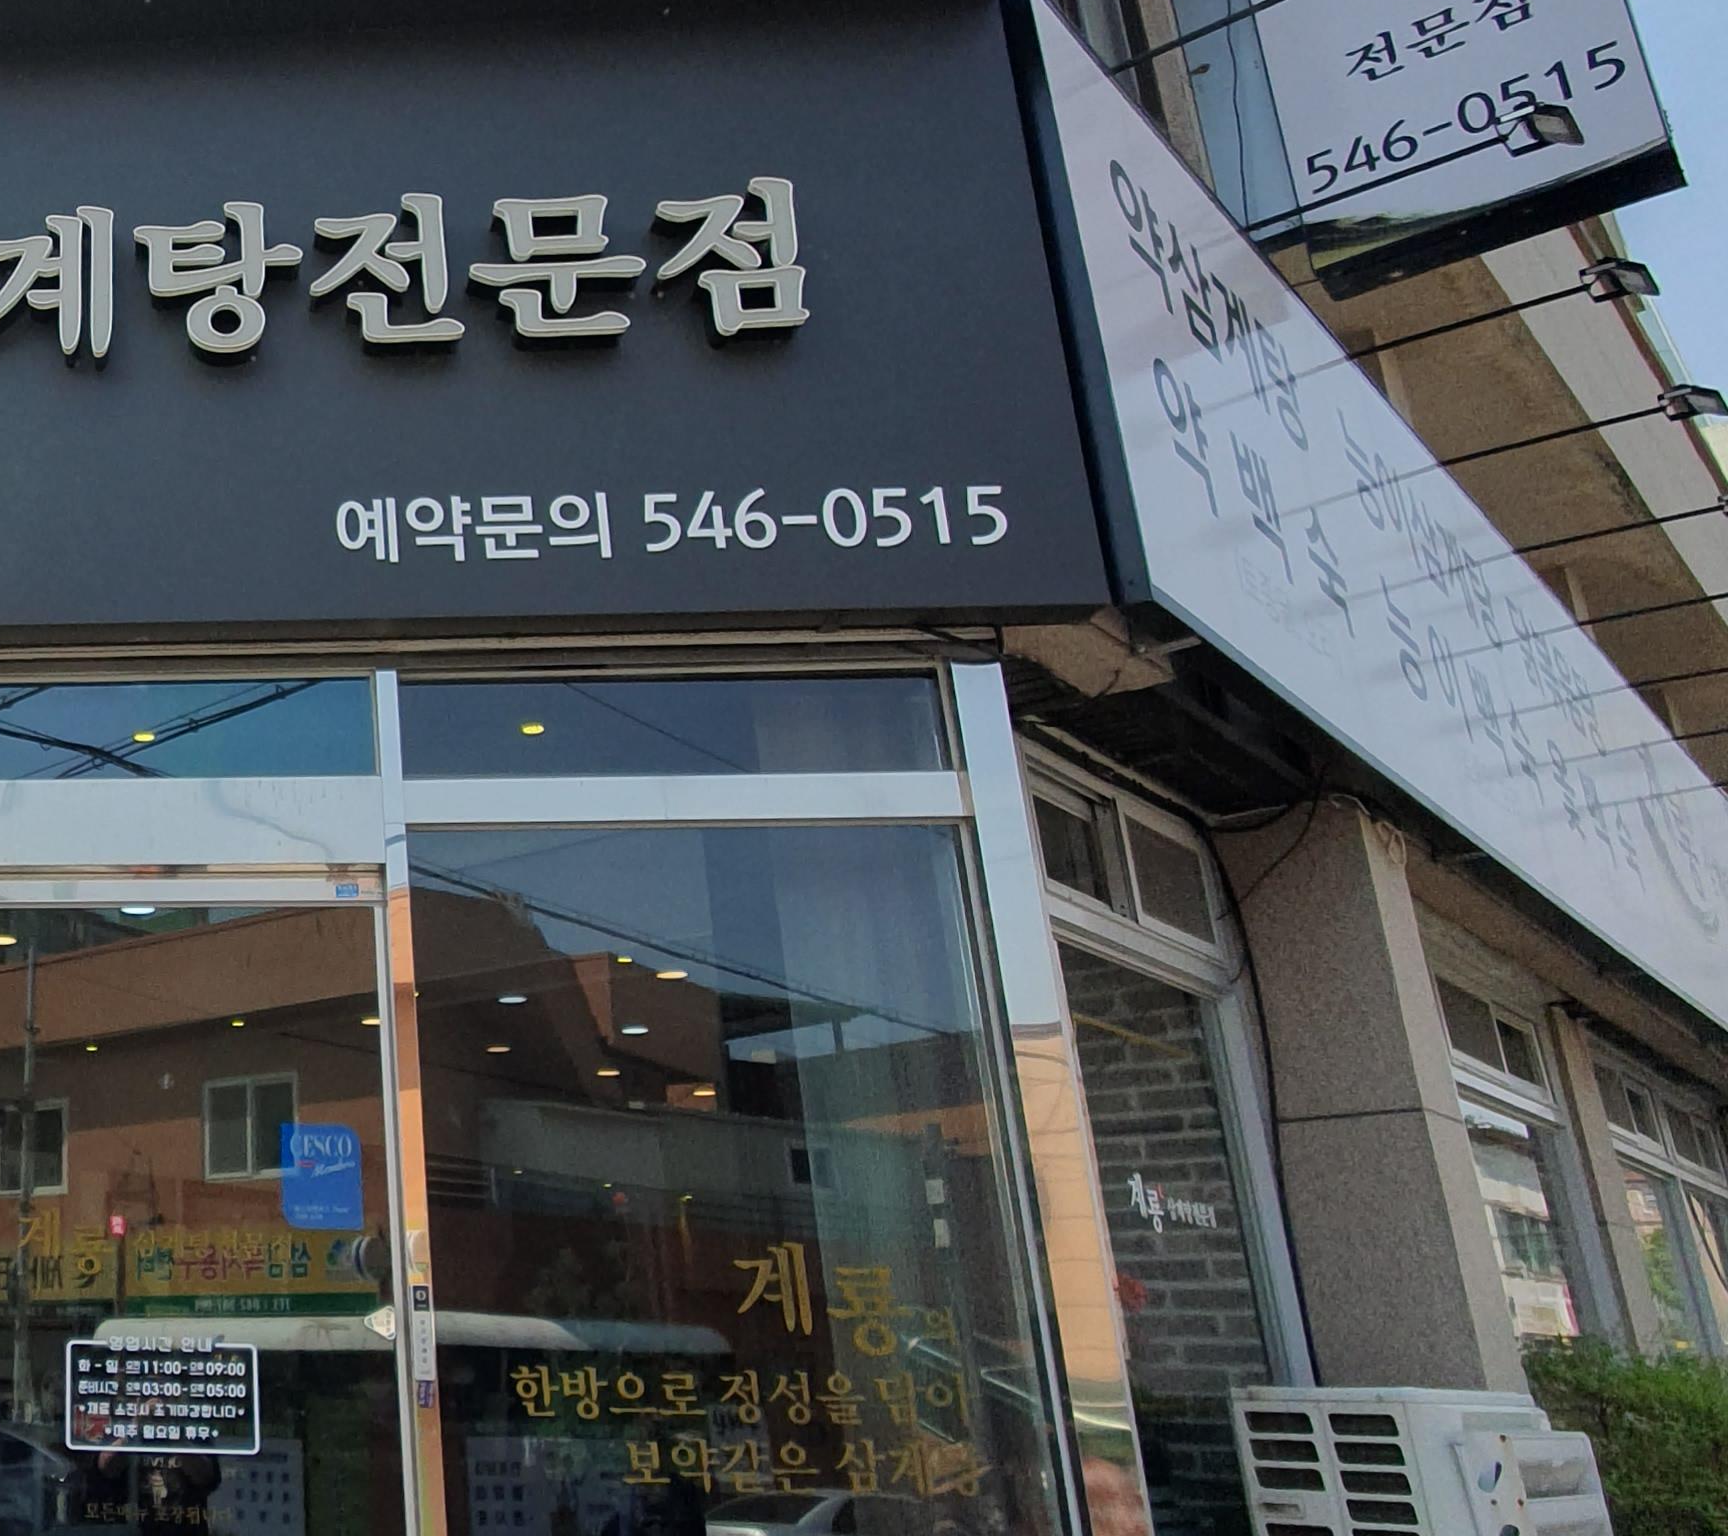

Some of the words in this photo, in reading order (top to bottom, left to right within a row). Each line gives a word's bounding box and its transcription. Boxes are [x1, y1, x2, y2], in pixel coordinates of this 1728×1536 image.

[1109, 159, 1309, 451] 약삼계탕
[335, 489, 614, 563] 예약문의
[645, 482, 1010, 554] 546-0515
[1336, 408, 1502, 649] 능이삼계탕
[290, 1133, 353, 1159] CESCO
[108, 1335, 173, 1353] 영업시간
[181, 1336, 214, 1353] 안내
[77, 1359, 90, 1373] 화
[153, 1403, 237, 1419] 조기마감합니다
[510, 1366, 706, 1421] 한방으로
[719, 1369, 864, 1426] 정성을
[113, 1423, 138, 1438] 매주
[142, 1424, 181, 1440] 월요일
[185, 1425, 210, 1441] 휴무
[621, 1442, 820, 1494] 보약같은
